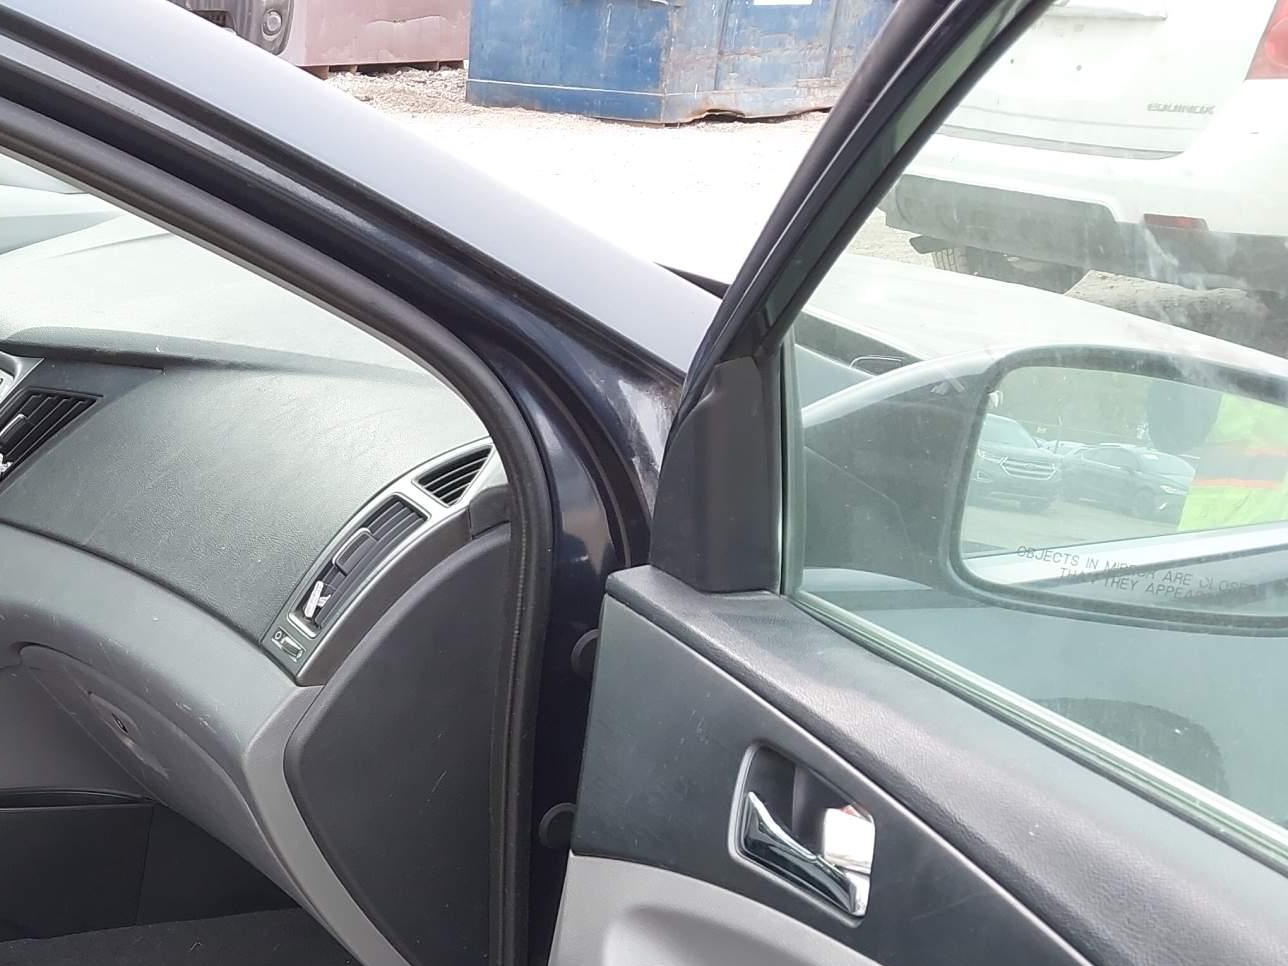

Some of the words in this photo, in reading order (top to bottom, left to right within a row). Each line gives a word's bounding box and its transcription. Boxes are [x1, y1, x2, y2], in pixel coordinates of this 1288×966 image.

[1147, 103, 1216, 115] EQUINOX
[1016, 545, 1080, 567] OBJECTS
[1085, 557, 1099, 570] IN
[1162, 570, 1193, 586] ARE
[1103, 575, 1139, 591] THEY
